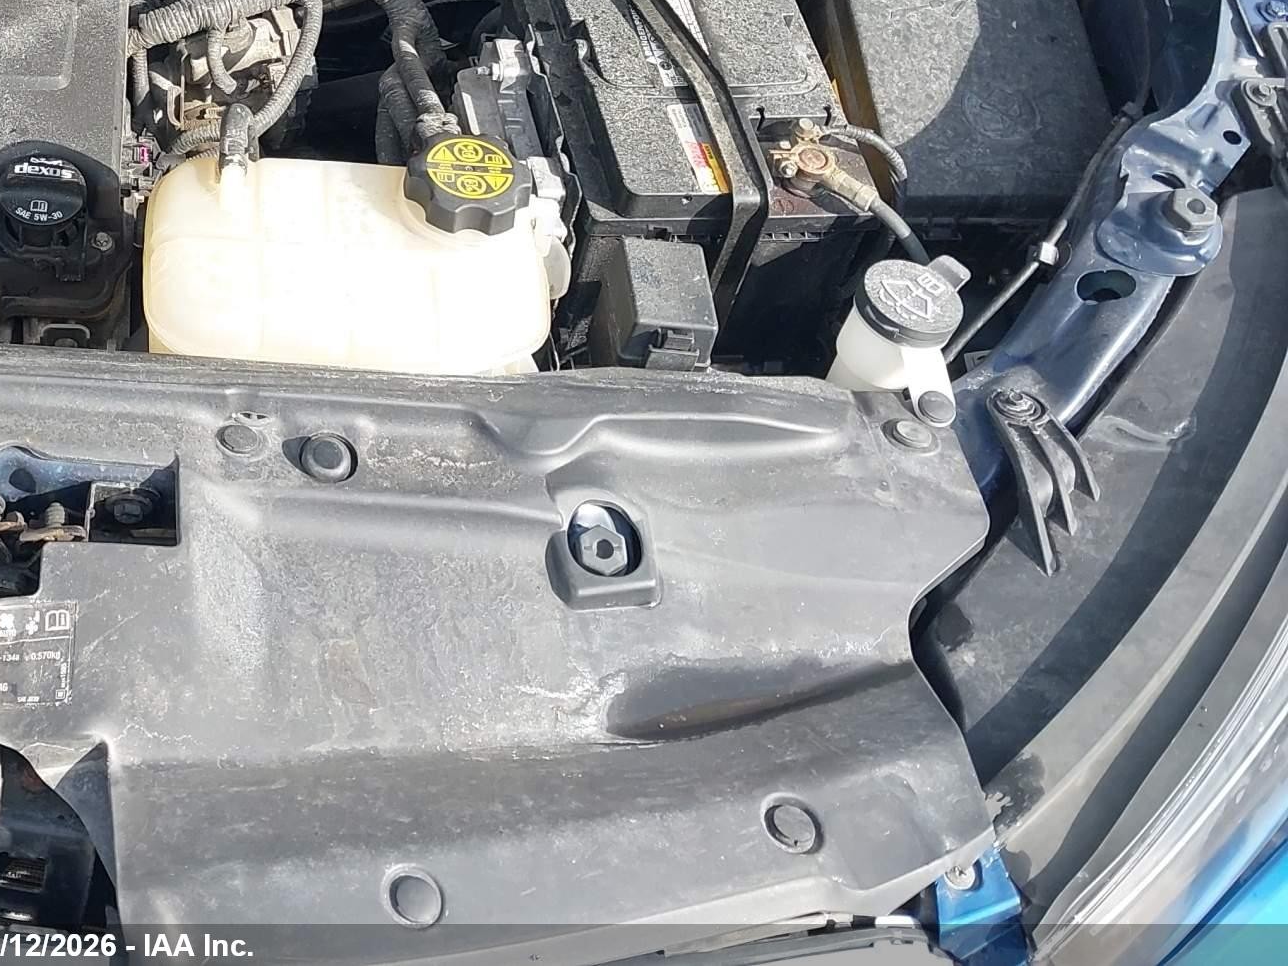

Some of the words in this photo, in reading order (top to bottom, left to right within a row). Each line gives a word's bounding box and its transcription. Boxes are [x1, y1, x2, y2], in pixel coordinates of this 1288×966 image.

[14, 162, 75, 179] dexos
[15, 206, 31, 219] SAE
[33, 210, 63, 221] 5W-30
